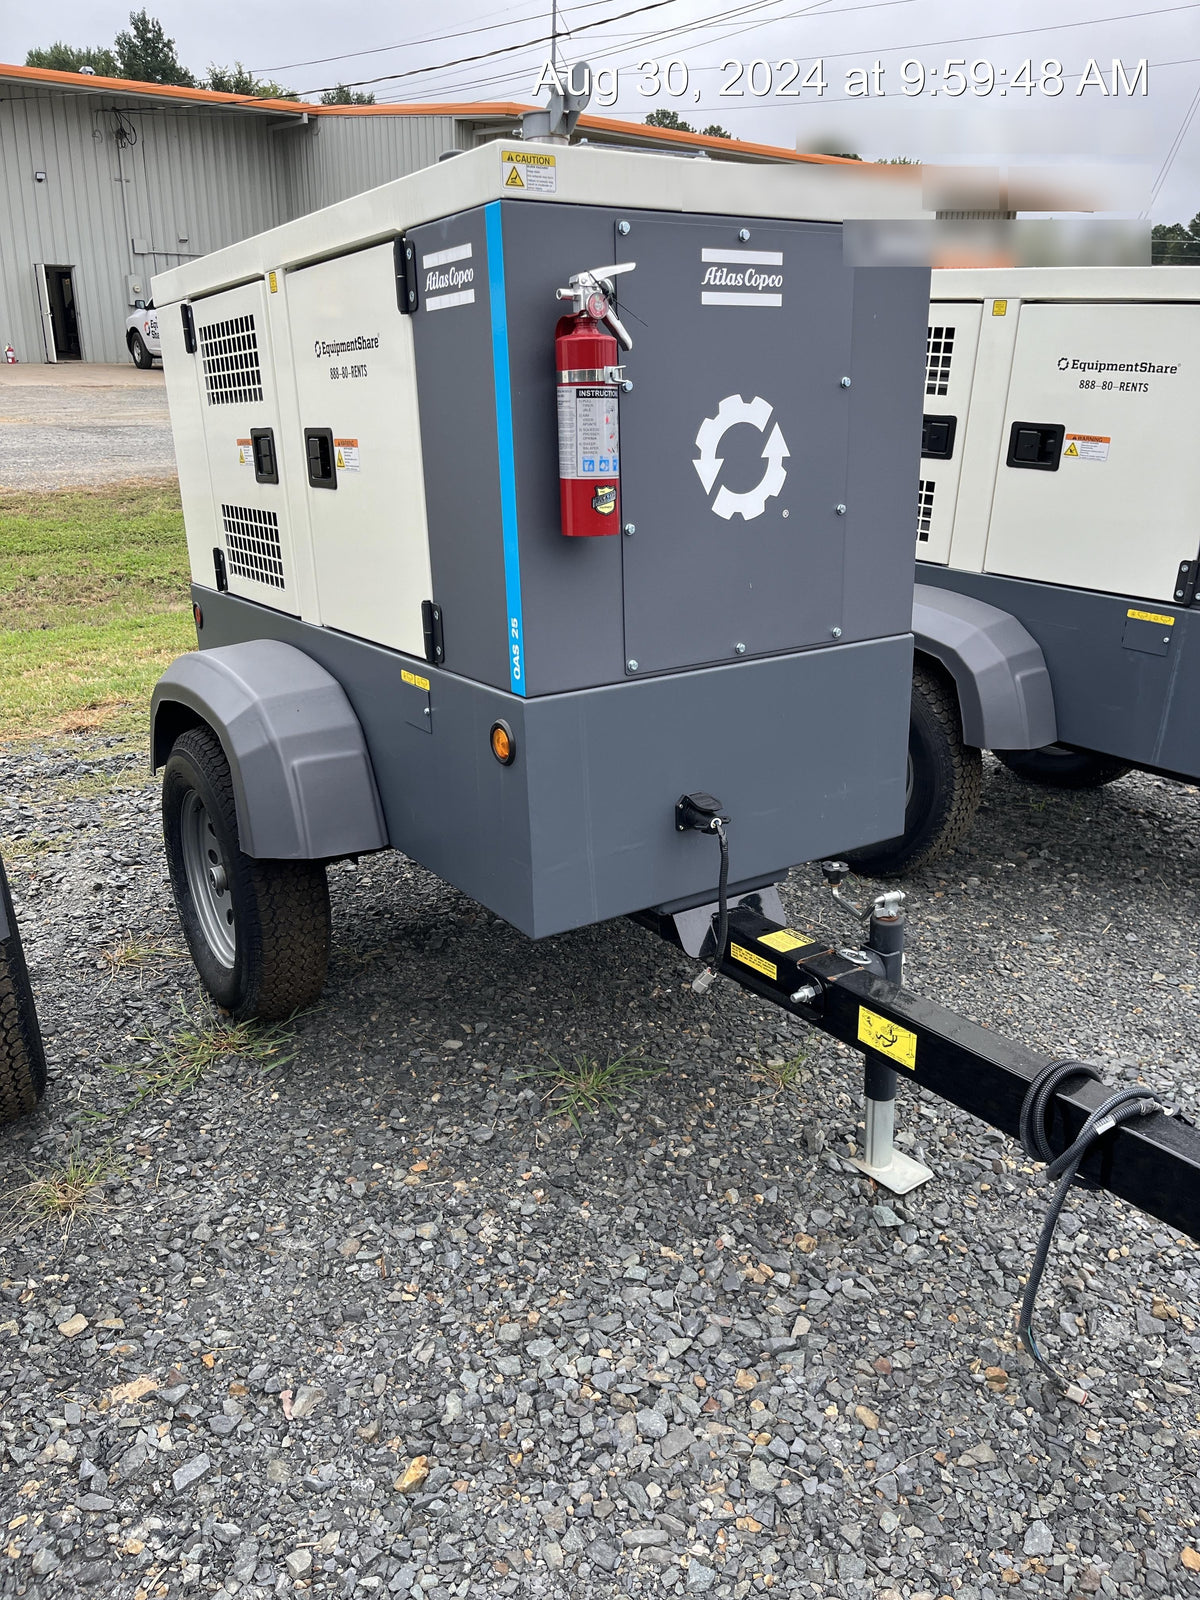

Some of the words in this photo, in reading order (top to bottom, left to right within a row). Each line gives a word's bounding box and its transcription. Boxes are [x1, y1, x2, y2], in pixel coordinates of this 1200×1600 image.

[515, 154, 550, 165] CAUTION
[424, 271, 449, 292] Atlas
[449, 266, 474, 289] Copco
[701, 266, 744, 286] Atlas
[744, 268, 783, 290] Copco
[321, 336, 379, 358] EquipmentShare
[329, 364, 368, 380] 888-80-RENTS
[1071, 359, 1178, 374] EquipmentShare
[1079, 380, 1149, 393] 888-80-RENTS
[511, 617, 518, 639] 25
[512, 644, 520, 680] QAS
